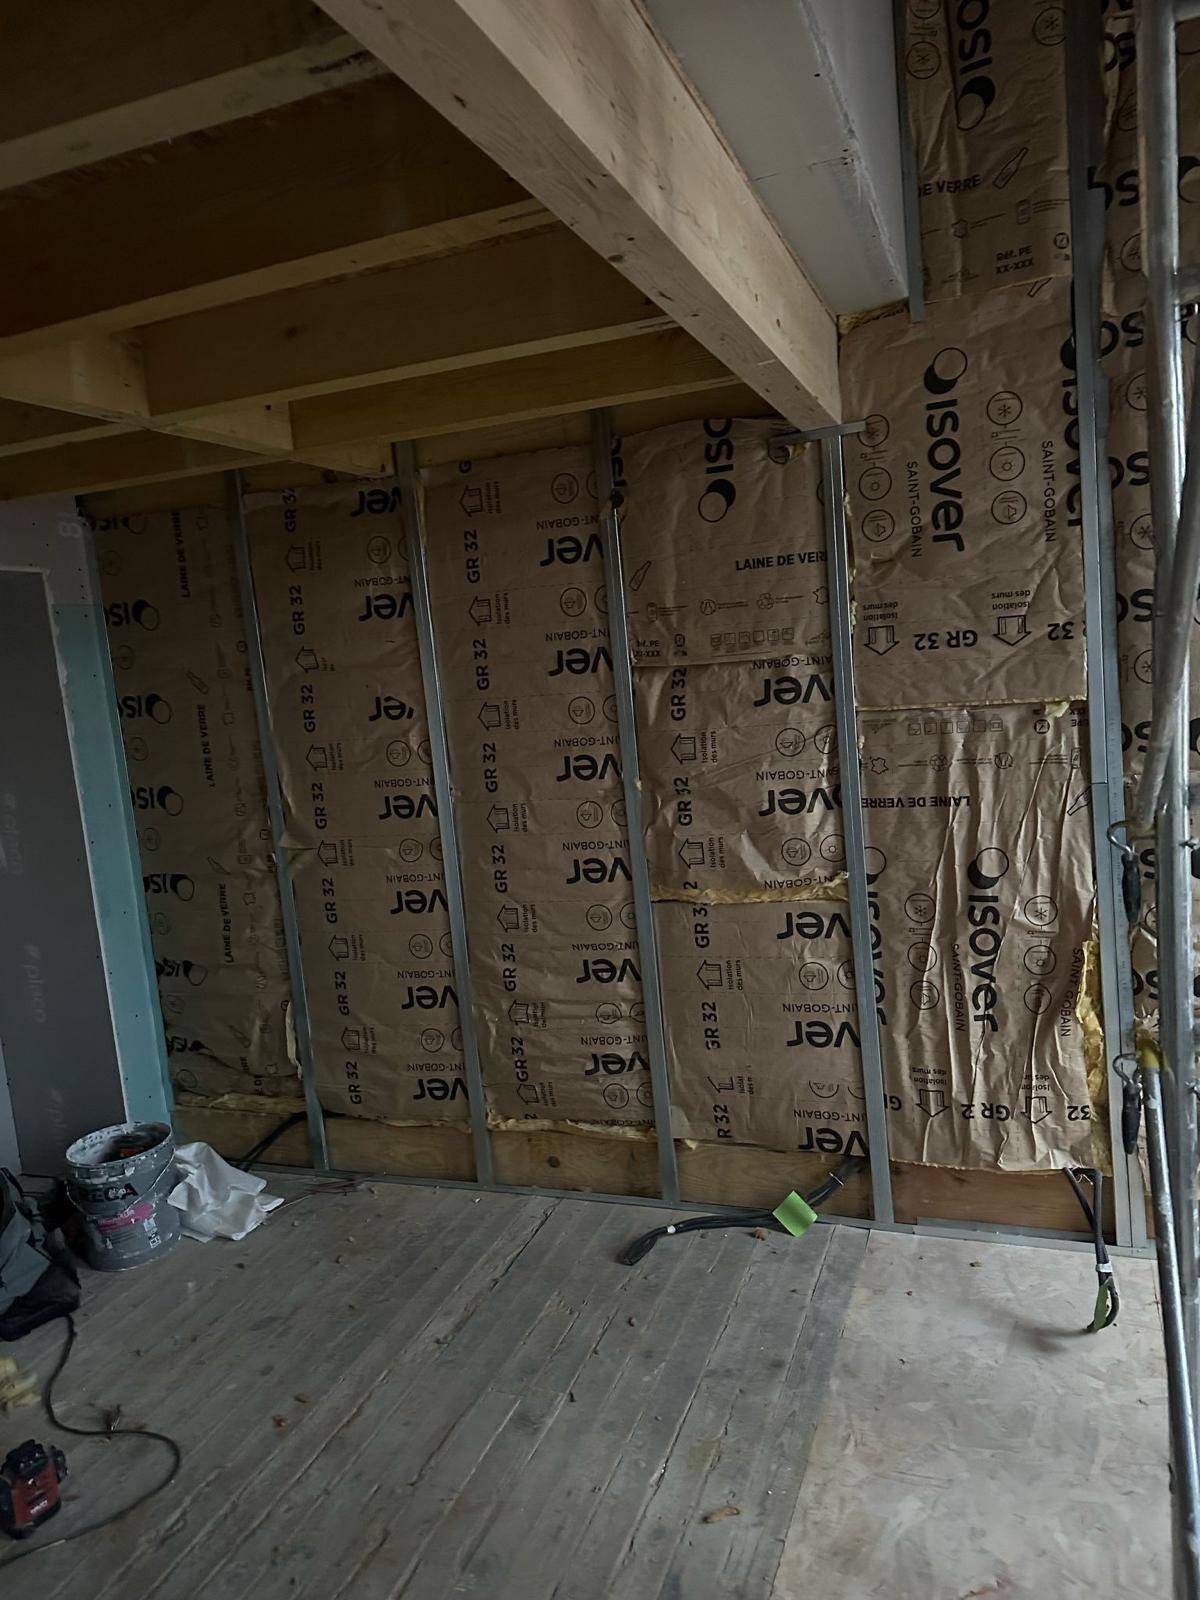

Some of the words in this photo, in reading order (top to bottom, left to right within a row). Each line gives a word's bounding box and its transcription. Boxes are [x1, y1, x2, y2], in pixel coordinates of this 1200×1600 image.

[935, 173, 982, 194] VERRE
[1041, 440, 1057, 543] SAINT-GOBAIN
[906, 459, 924, 559] SAINT-GOBAIN
[464, 529, 478, 553] 32
[466, 556, 481, 584] GR
[735, 555, 775, 571] LAINE
[776, 554, 795, 566] DE
[288, 585, 303, 607] 32
[292, 611, 305, 636] GR
[1048, 621, 1075, 641] 32
[473, 638, 488, 661] 32
[913, 632, 940, 652] 32
[946, 629, 978, 649] GR
[475, 664, 490, 691] GR
[671, 668, 687, 689] 32
[300, 684, 315, 705] 32
[670, 693, 687, 721] GR
[197, 704, 209, 738] VERRE
[303, 708, 317, 733] GR
[201, 741, 211, 755] DE
[482, 741, 497, 763] 32
[203, 757, 215, 788] LAINE
[484, 767, 498, 793] GR
[311, 782, 325, 803] 32
[861, 797, 904, 809] VERRE
[906, 797, 926, 807] DE
[314, 806, 328, 830] GR
[677, 800, 693, 826] GR
[490, 844, 506, 865] 32
[321, 877, 335, 897] 32
[494, 869, 508, 893] GR
[218, 883, 230, 915] VERRE
[325, 901, 338, 924] GR
[692, 903, 709, 918] 3
[222, 919, 232, 931] DE
[695, 922, 711, 948] GR
[222, 934, 234, 964] LAINE
[501, 943, 516, 963] 32
[333, 970, 347, 990] 32
[503, 967, 517, 992] GR
[337, 994, 351, 1016] GR
[701, 1001, 718, 1024] 32
[511, 1036, 525, 1057] 32
[345, 1061, 360, 1080] 32
[513, 1059, 528, 1082] GR
[348, 1083, 362, 1105] GR
[712, 1103, 730, 1123] 32
[981, 1102, 1011, 1122] GR
[1067, 1105, 1091, 1122] 32
